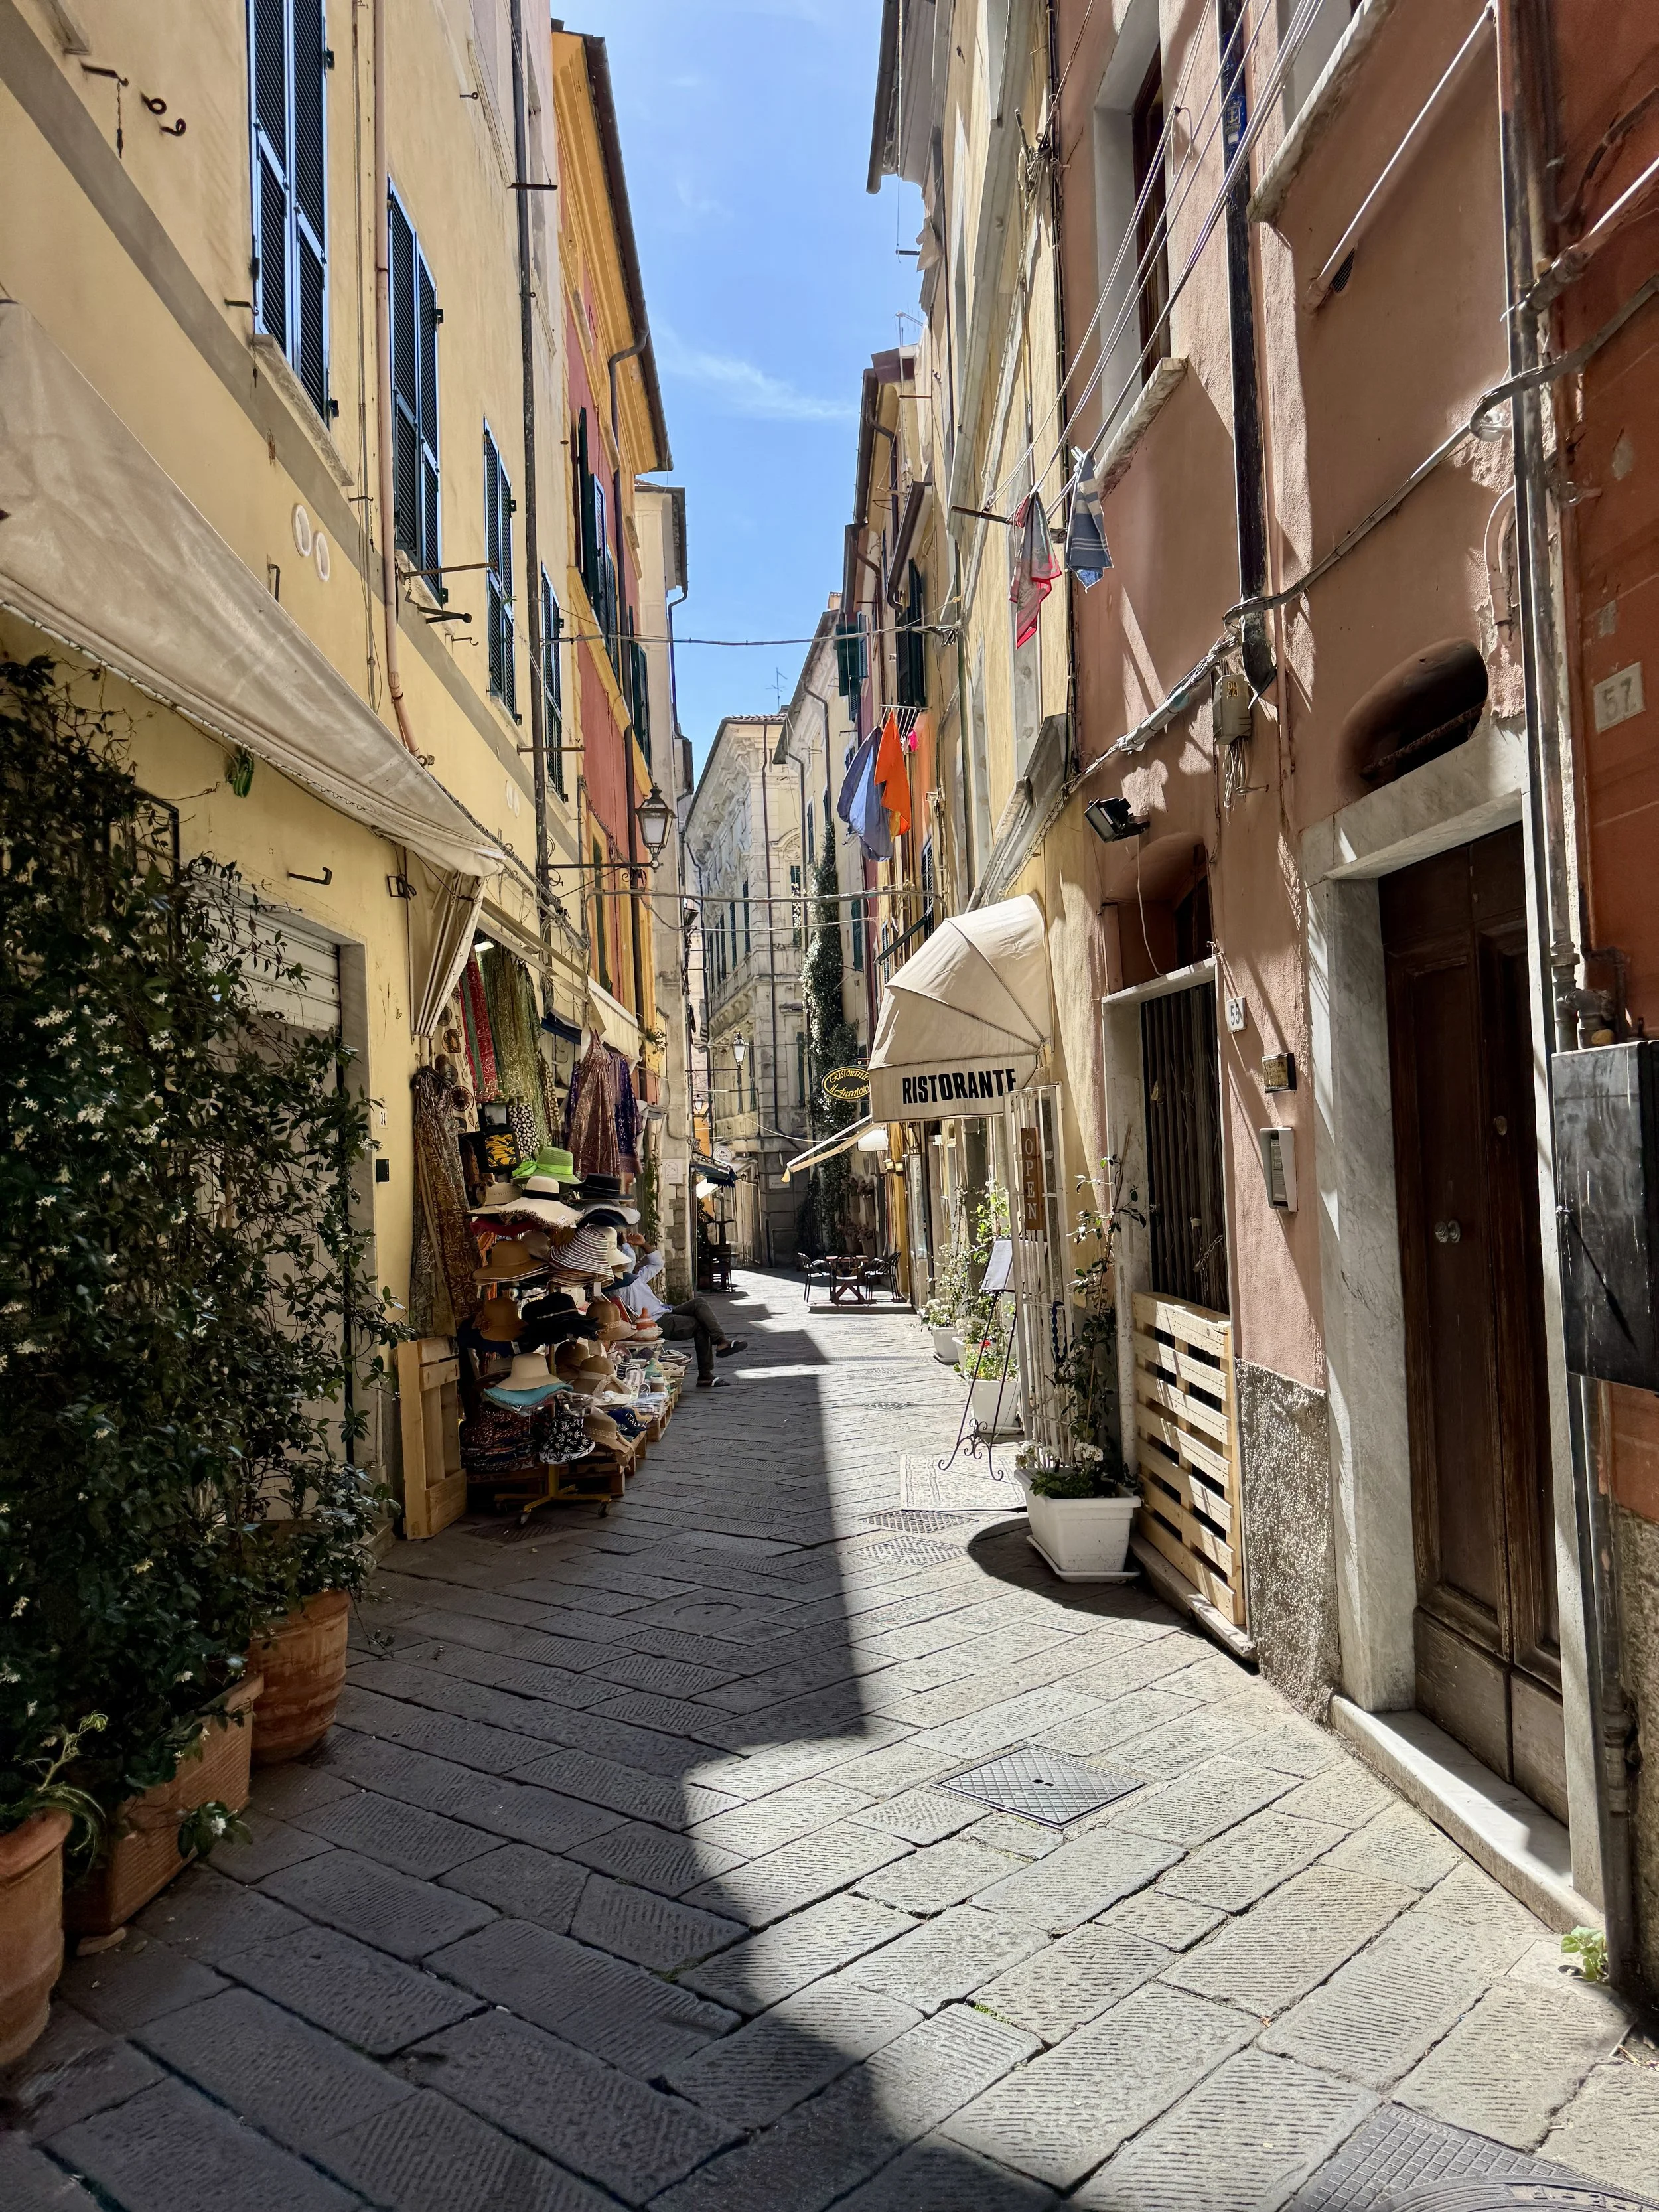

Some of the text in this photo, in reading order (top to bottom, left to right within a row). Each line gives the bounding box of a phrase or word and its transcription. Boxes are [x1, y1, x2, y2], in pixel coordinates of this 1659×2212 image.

[1603, 677, 1632, 721] 57
[1230, 1004, 1241, 1025] 55
[902, 1068, 1017, 1104] RISTORANTE
[1025, 1138, 1037, 1220] OPEN
